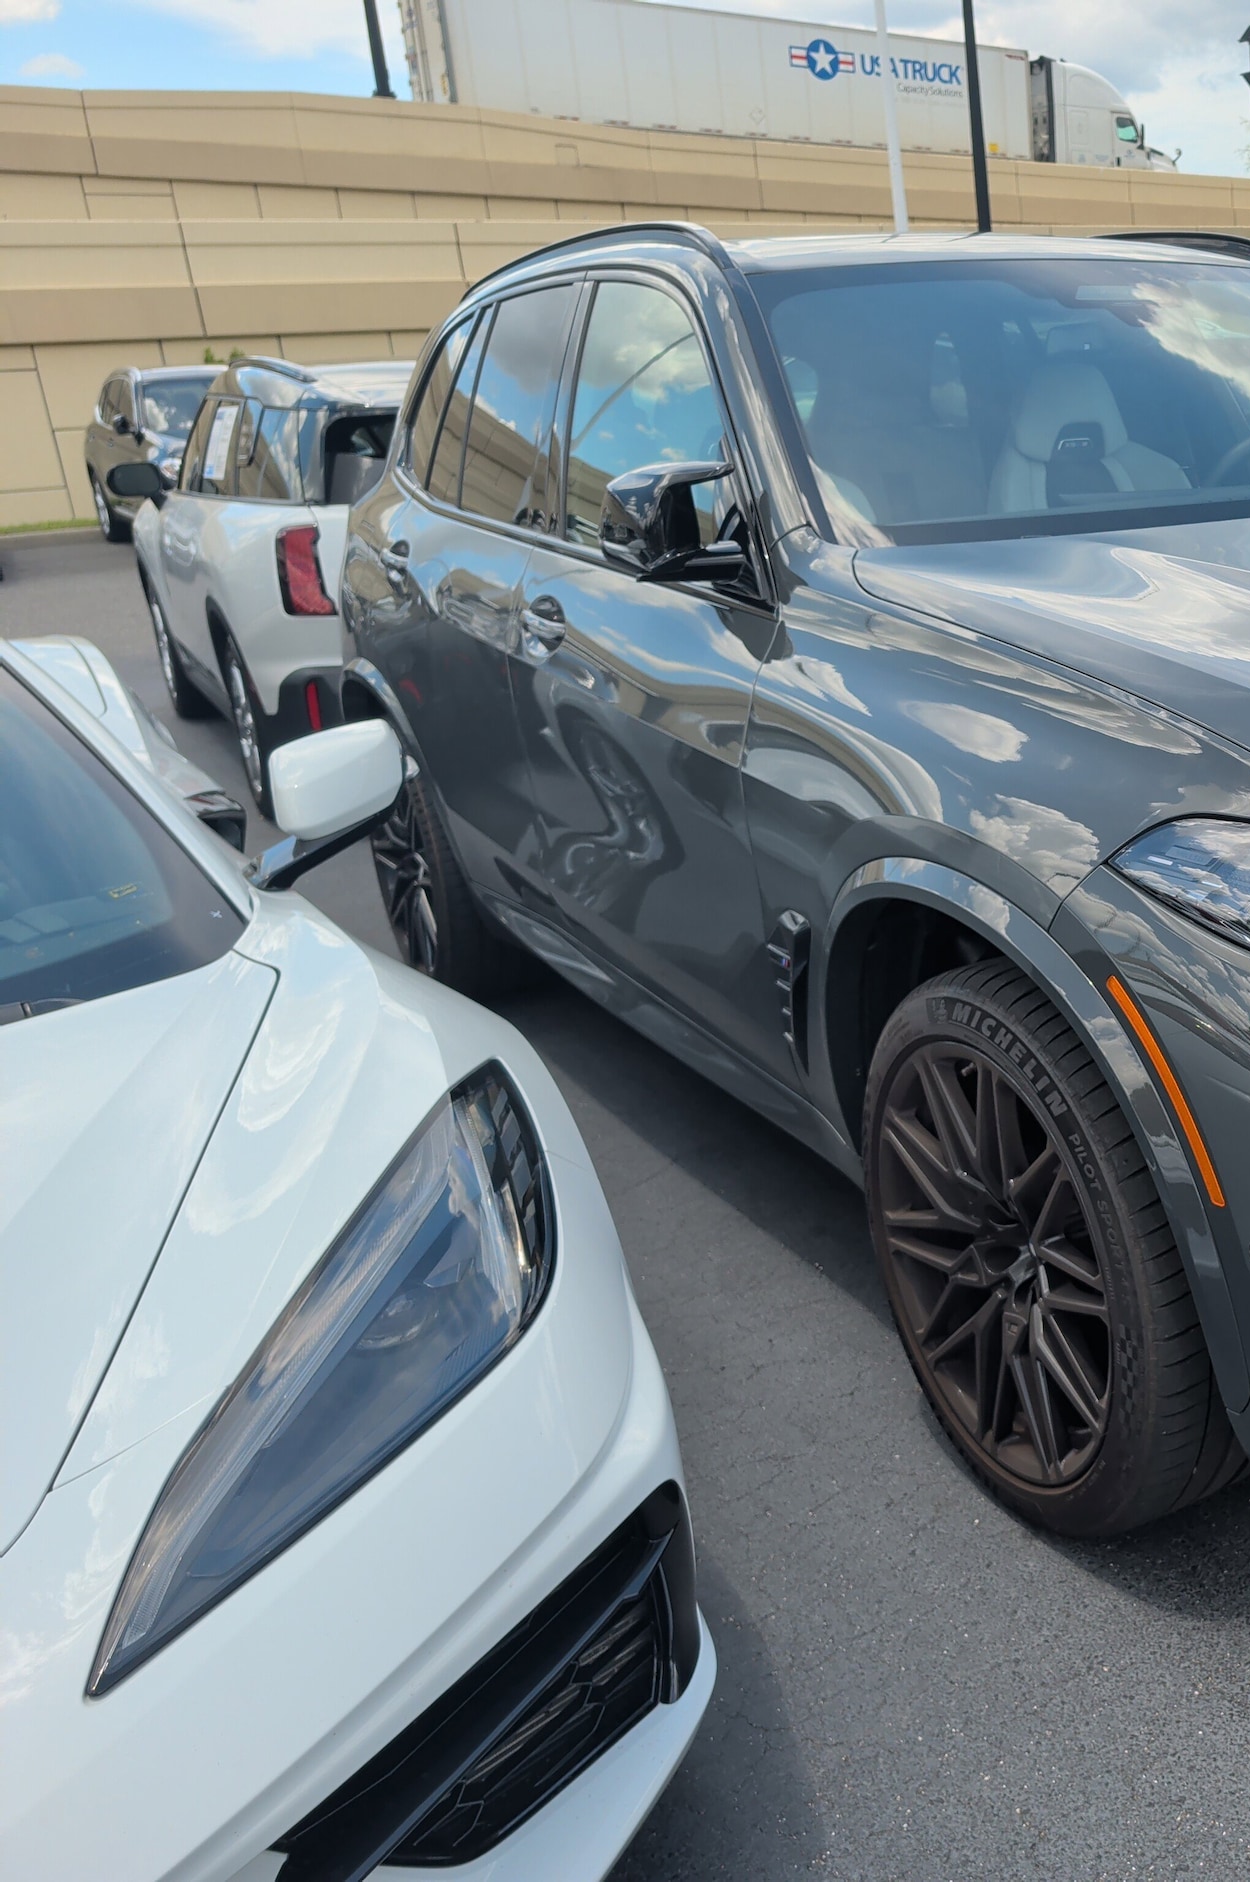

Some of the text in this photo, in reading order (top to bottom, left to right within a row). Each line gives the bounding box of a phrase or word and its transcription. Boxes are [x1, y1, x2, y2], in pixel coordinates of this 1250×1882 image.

[899, 58, 962, 85] TRUCK
[951, 1001, 1070, 1118] MICHELIN
[1068, 1132, 1104, 1191] PILOT
